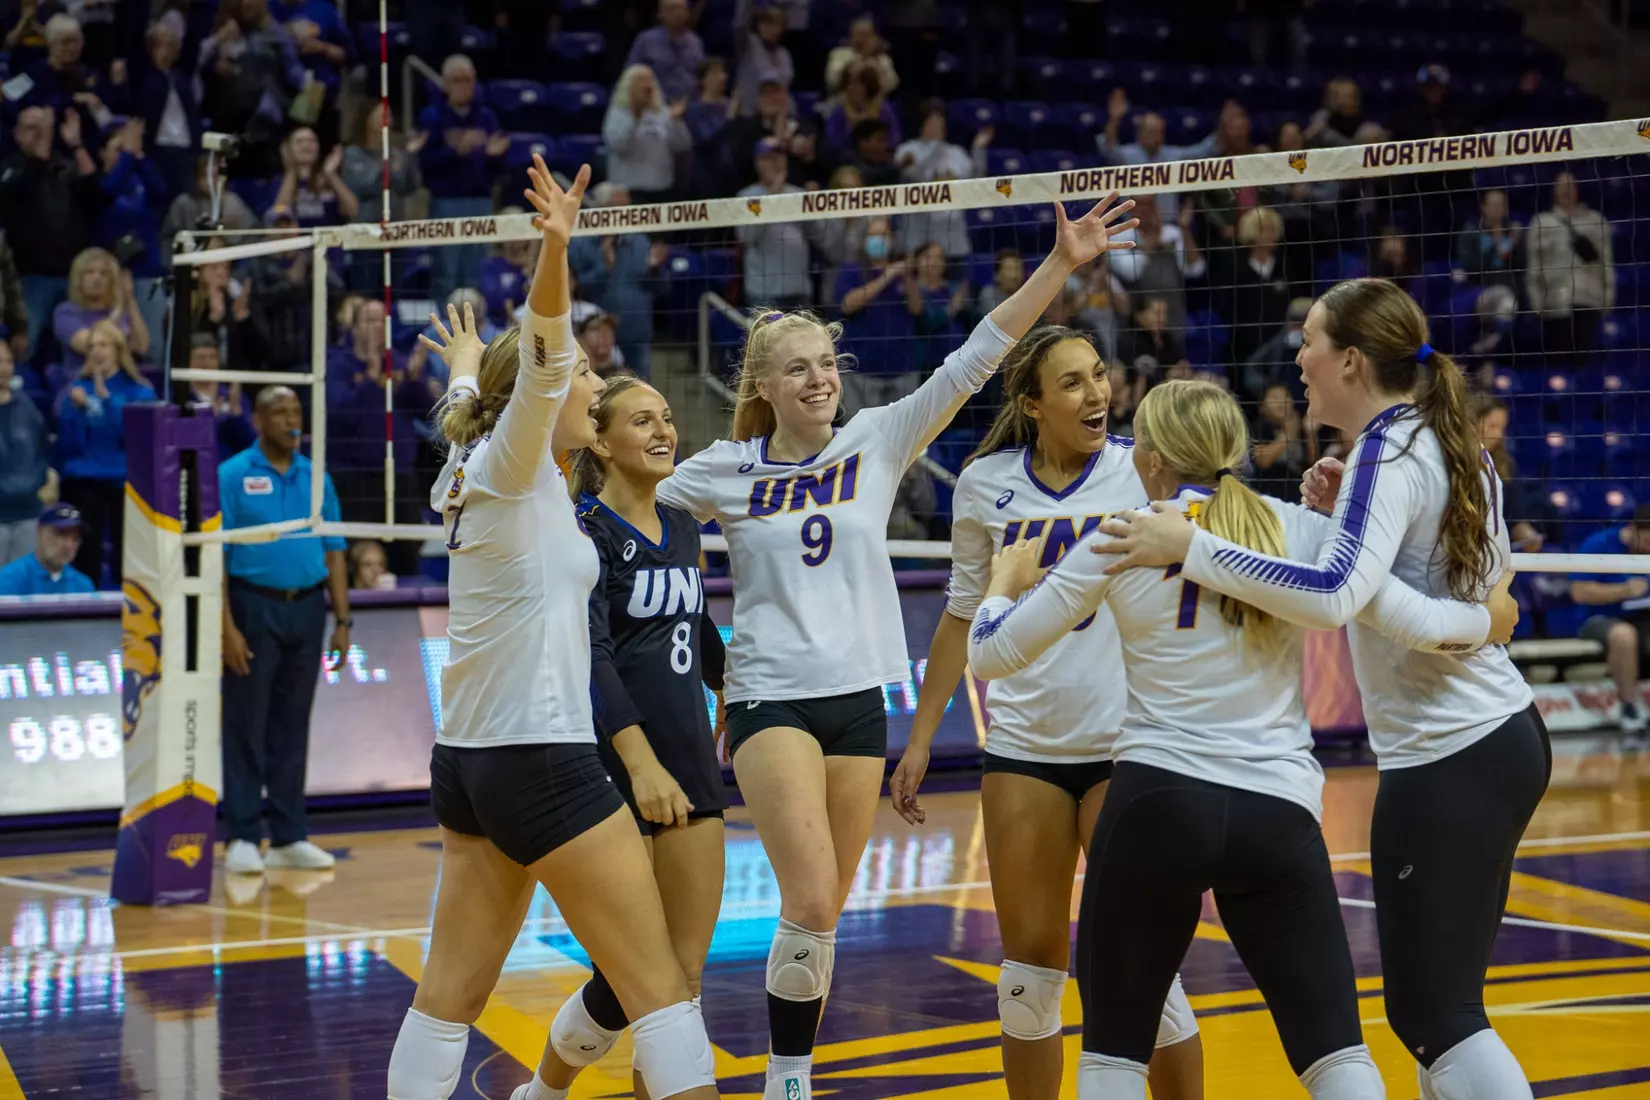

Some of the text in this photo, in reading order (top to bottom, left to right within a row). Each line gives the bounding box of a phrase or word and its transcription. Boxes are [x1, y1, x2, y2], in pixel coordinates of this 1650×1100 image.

[1362, 128, 1573, 169] NORTHERN IOWA
[802, 183, 952, 213] NORTHERN IOWA
[1060, 158, 1235, 194] NORTHERN IOWA
[380, 219, 498, 242] NORTHERN IOWA
[578, 203, 709, 229] NORTHERN IOWA
[747, 451, 863, 519] UNI
[801, 513, 832, 567] 9
[670, 621, 693, 675] 8
[9, 713, 121, 763] 988
[184, 699, 198, 752] sports
